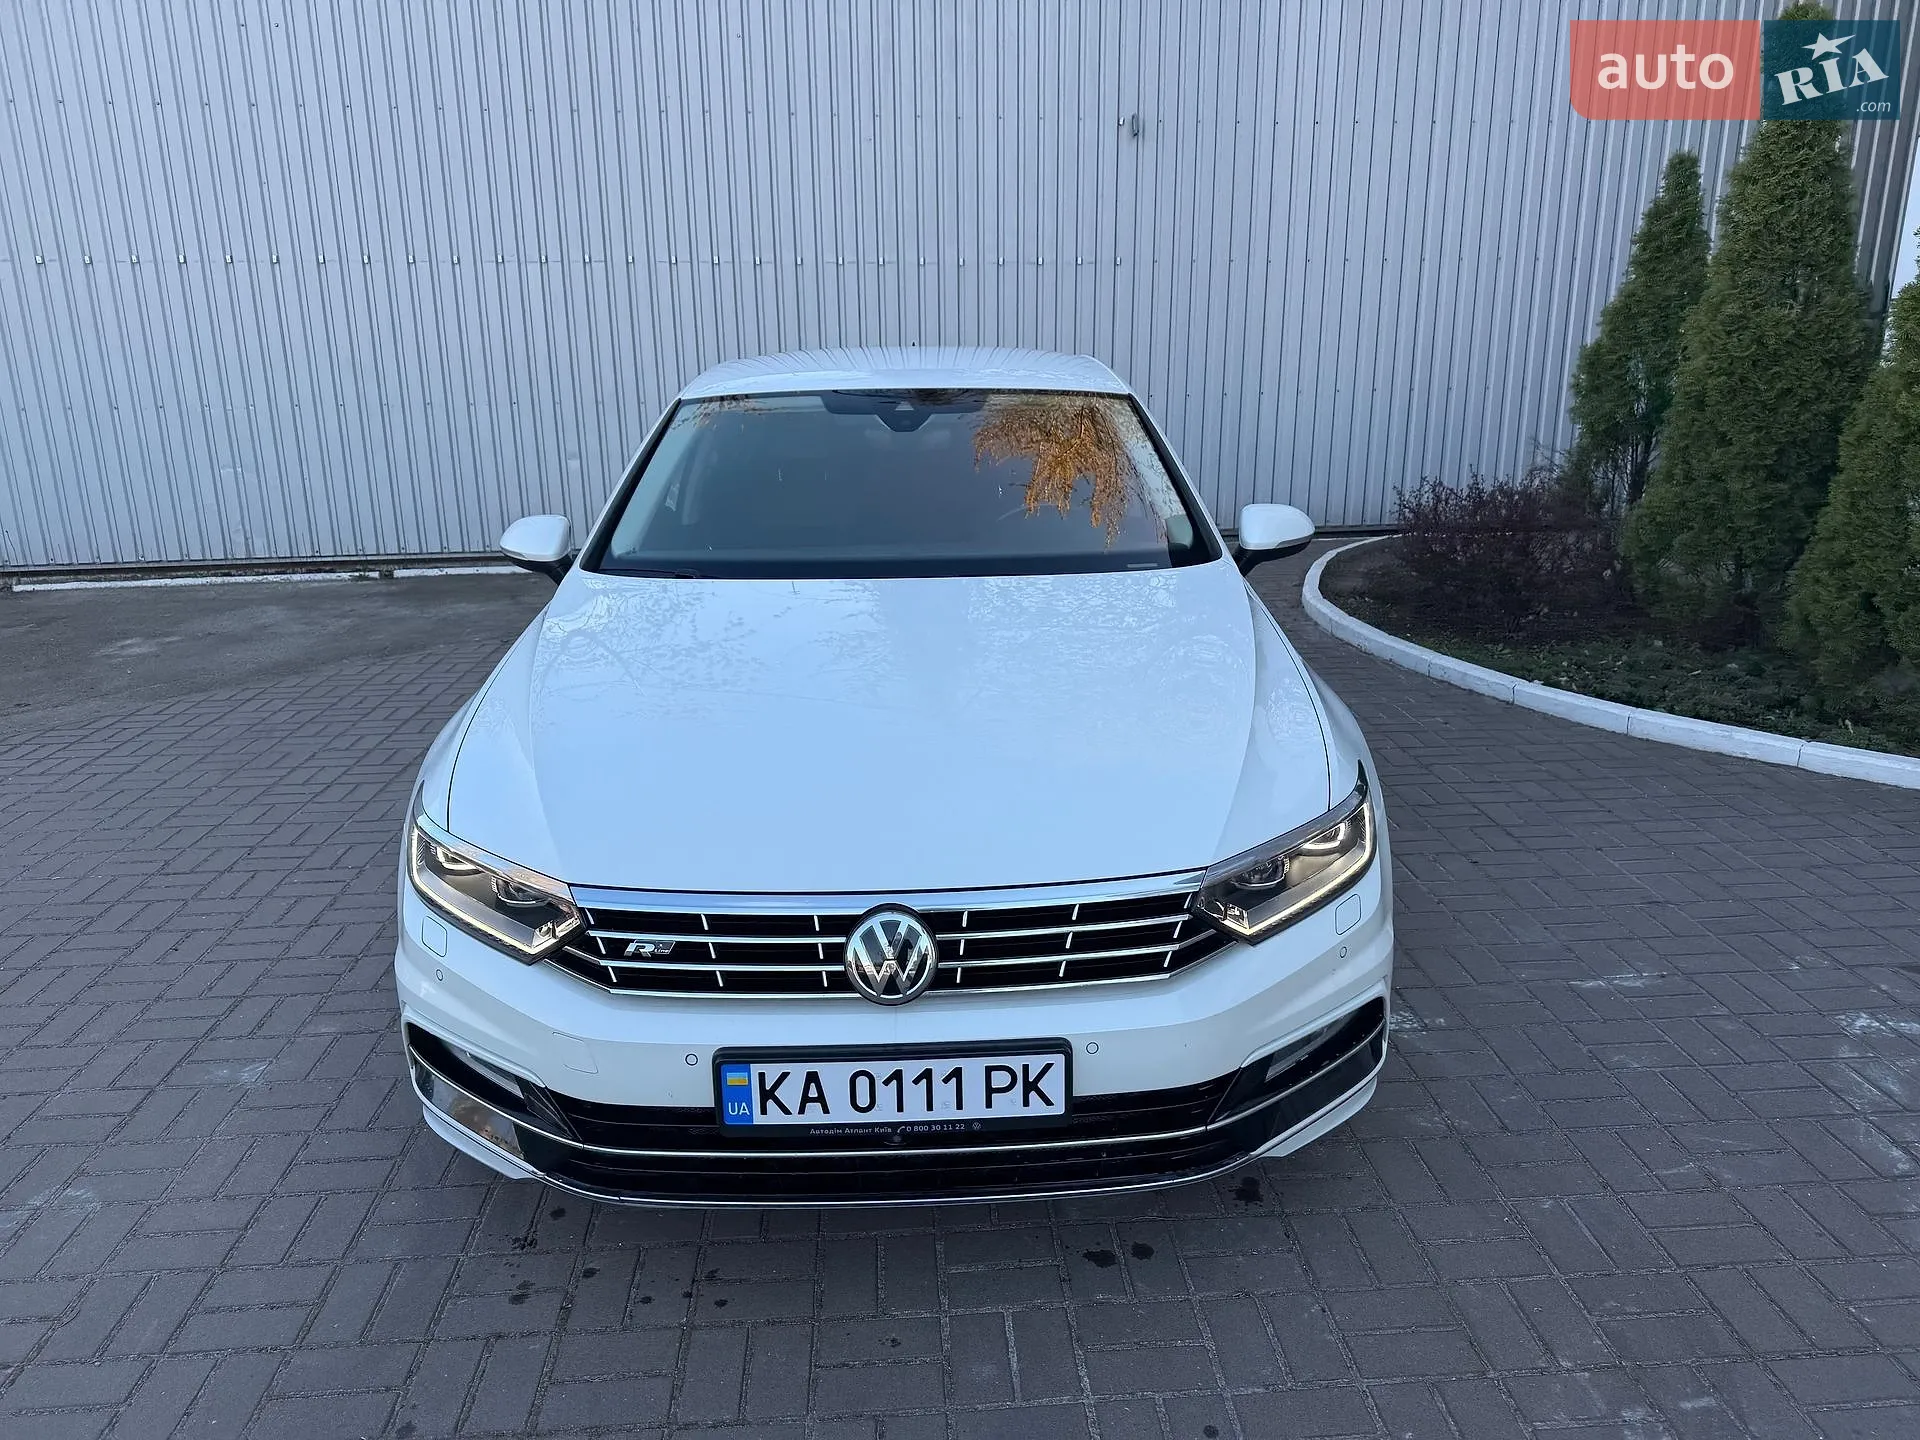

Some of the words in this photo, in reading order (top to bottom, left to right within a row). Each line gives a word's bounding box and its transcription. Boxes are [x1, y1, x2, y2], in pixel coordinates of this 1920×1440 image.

[758, 1070, 831, 1116] KA
[849, 1066, 964, 1114] 0111
[984, 1062, 1056, 1110] PK
[728, 1102, 750, 1116] UA
[844, 1126, 873, 1135] Атлант
[874, 1125, 893, 1134] Київ
